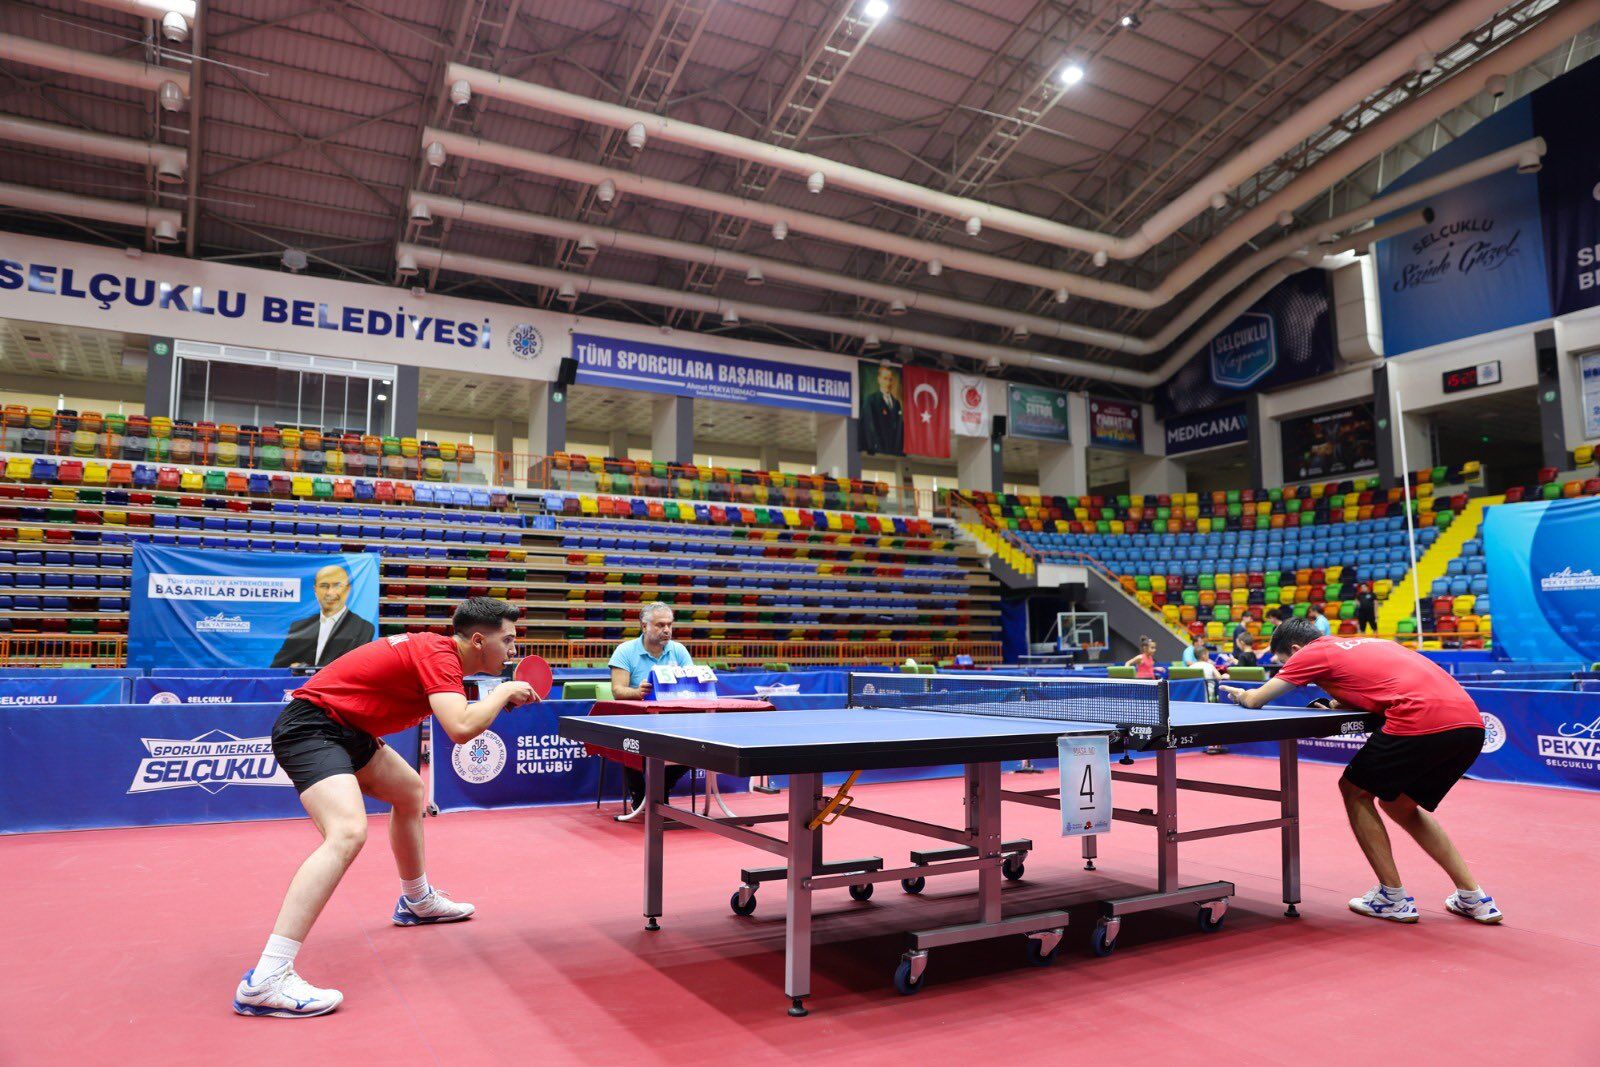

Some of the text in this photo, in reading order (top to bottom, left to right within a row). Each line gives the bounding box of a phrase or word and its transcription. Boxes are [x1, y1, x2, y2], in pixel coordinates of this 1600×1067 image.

[0, 258, 247, 318] SELÇUKLU
[262, 296, 490, 350] BELEDİYESİ
[577, 342, 850, 399] TÜM SPORCULARA BAŞARILAR DİLERİM
[1167, 415, 1241, 444] MEDICANA
[155, 584, 235, 597] BAŞARILAR
[153, 743, 273, 756] SPORUN MERKEZ
[143, 757, 278, 784] SELÇUKLU
[516, 761, 573, 775] KULÜBÜ
[1545, 758, 1593, 770] SELÇUKLU
[1079, 764, 1095, 803] 4
